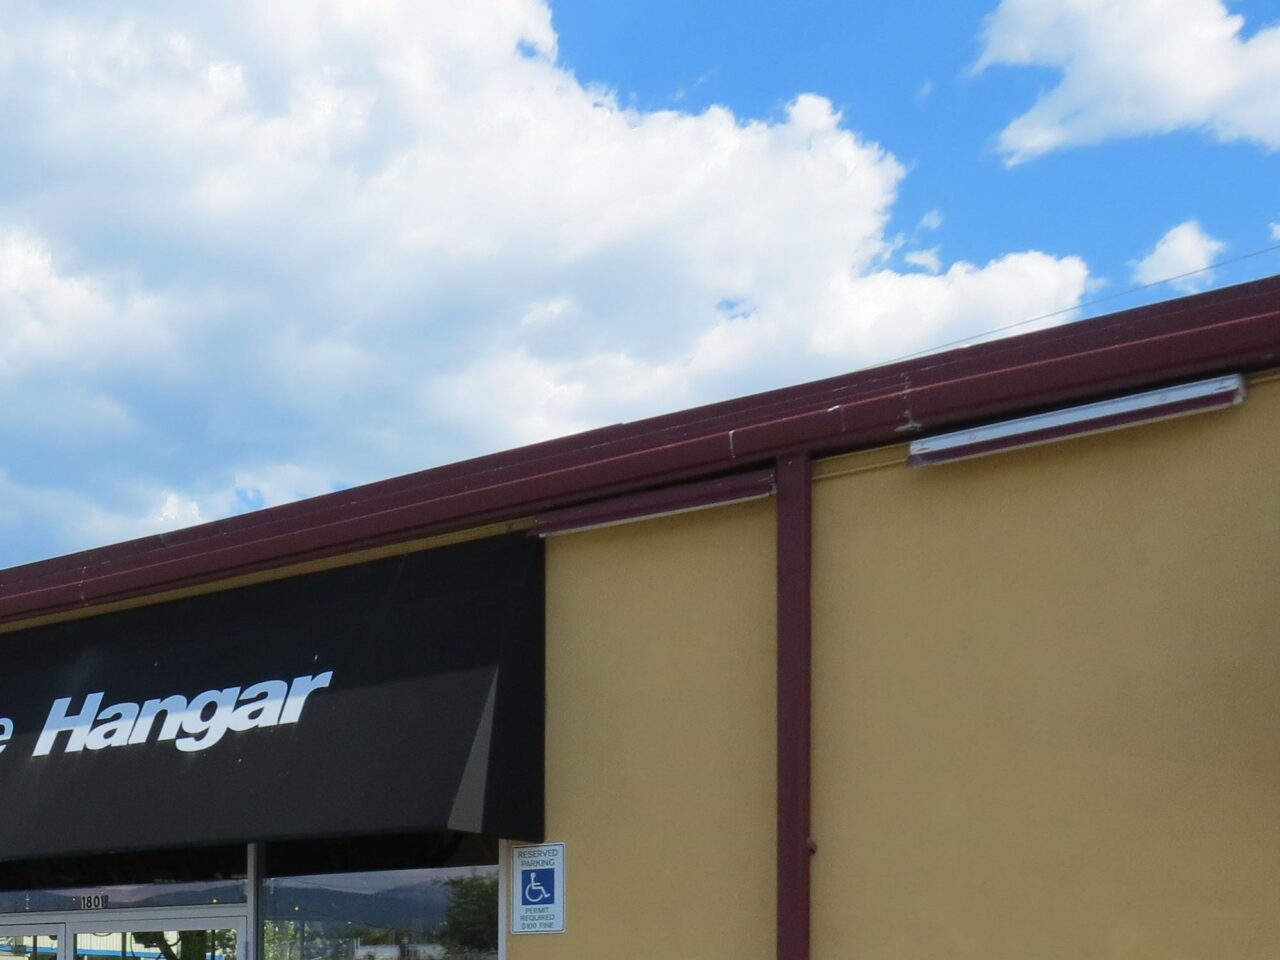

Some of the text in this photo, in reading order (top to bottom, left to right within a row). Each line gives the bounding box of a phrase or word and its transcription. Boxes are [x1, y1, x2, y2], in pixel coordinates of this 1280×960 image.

[31, 670, 334, 756] Hangar
[518, 849, 559, 858] RESERVED
[521, 858, 555, 867] PARKING
[82, 895, 105, 909] 1801
